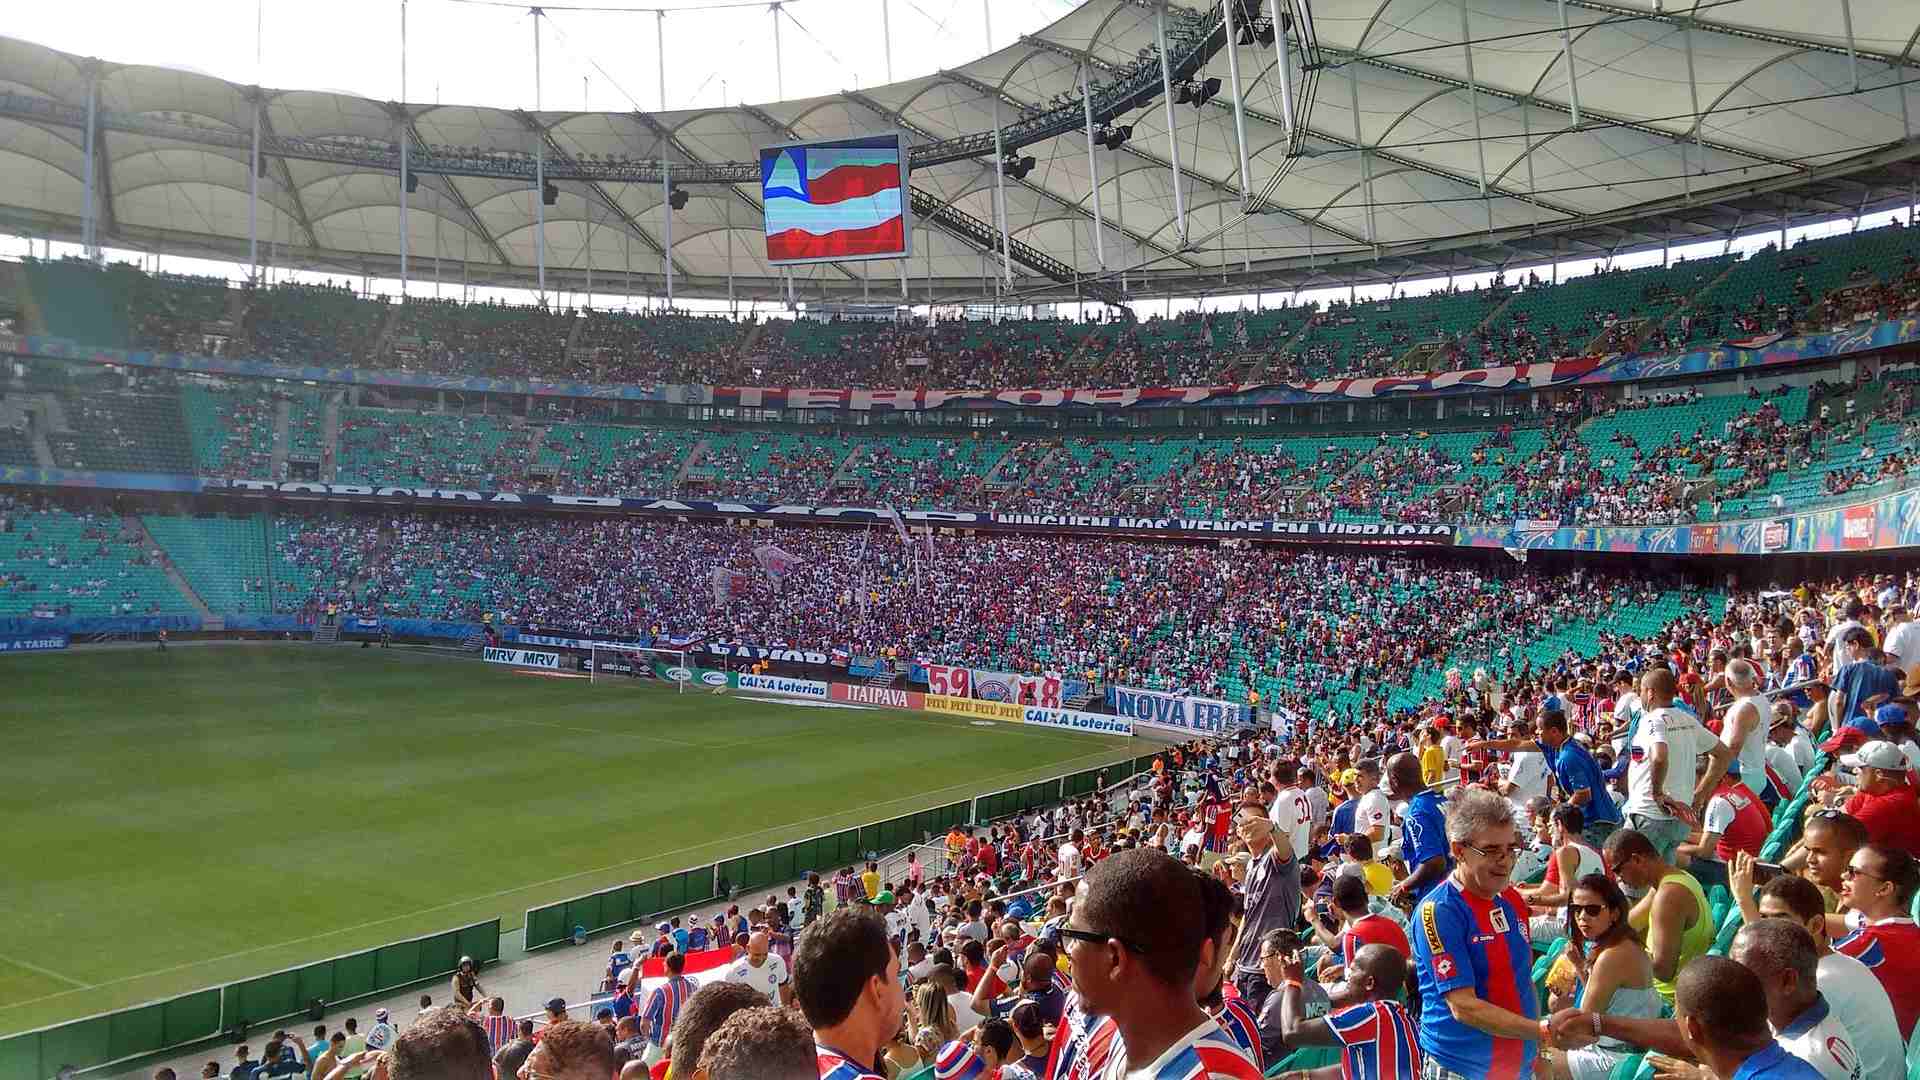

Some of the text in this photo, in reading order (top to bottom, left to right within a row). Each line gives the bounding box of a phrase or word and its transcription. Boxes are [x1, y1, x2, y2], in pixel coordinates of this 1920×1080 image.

[484, 647, 557, 667] MRV MRV
[739, 675, 776, 690] CAIXA
[777, 679, 825, 697] Loterias
[928, 664, 969, 698] 59
[847, 684, 909, 708] ITAIPAVA
[1118, 688, 1187, 727] NOVA
[1025, 708, 1133, 734] CAIXA Loterias
